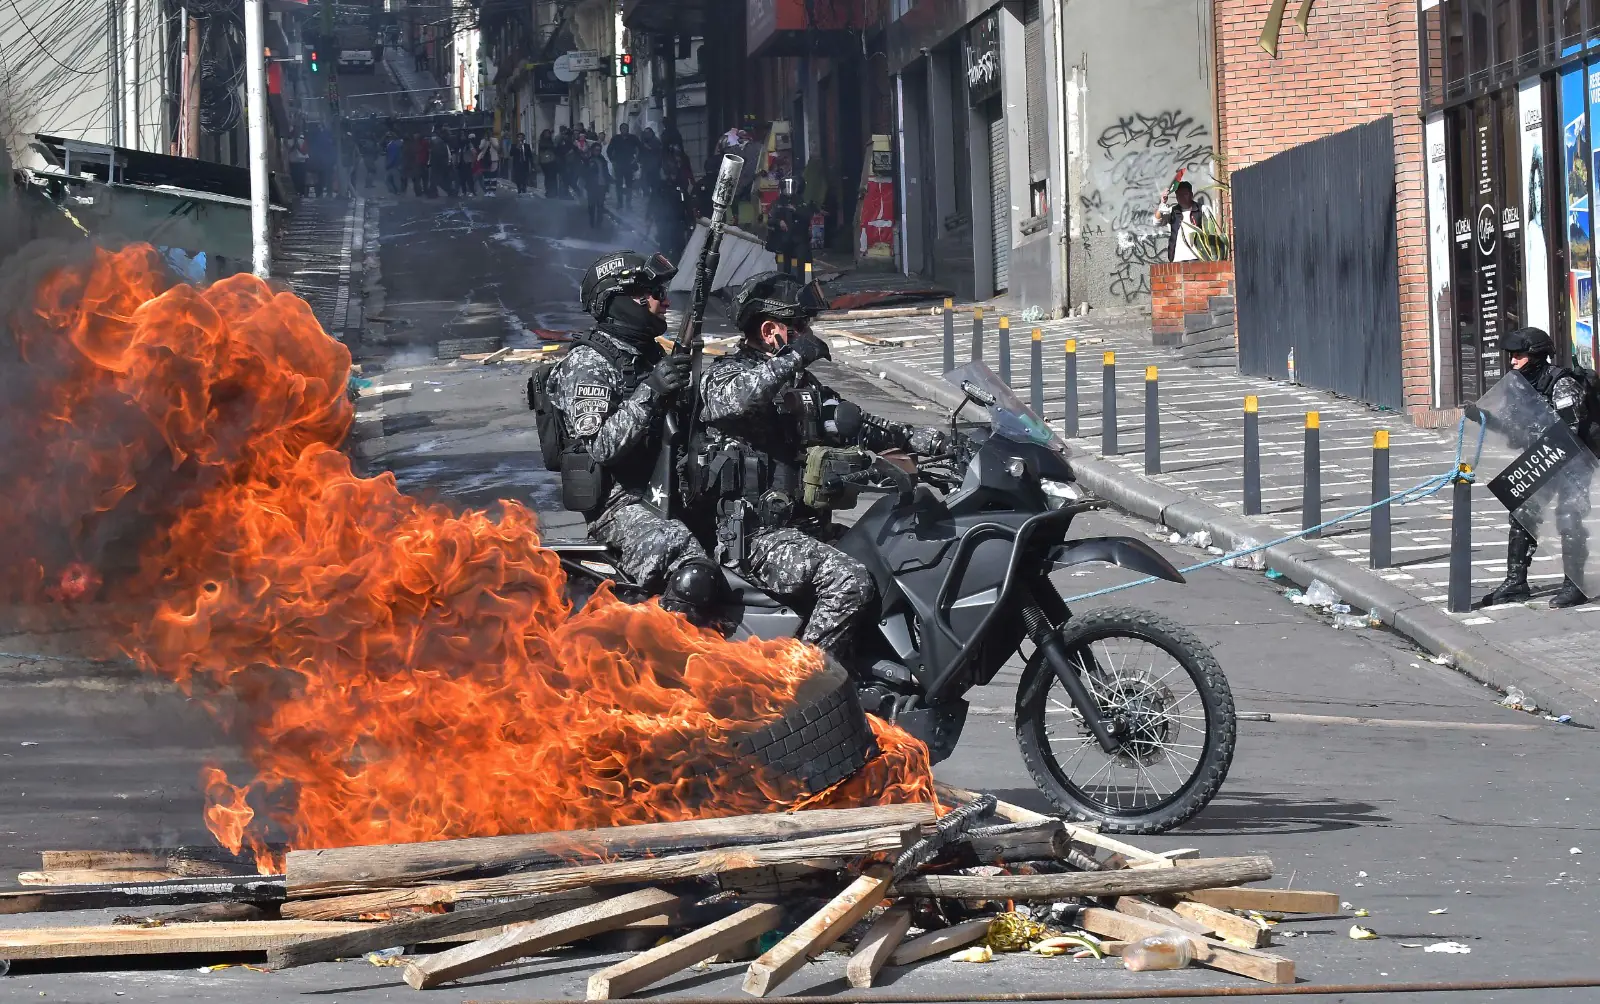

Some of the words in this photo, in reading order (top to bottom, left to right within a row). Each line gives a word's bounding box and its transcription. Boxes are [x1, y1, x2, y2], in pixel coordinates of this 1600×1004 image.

[577, 386, 606, 397] POLICIA
[1507, 444, 1552, 485] POLICIA
[1509, 447, 1567, 498] BOLIVIANA
